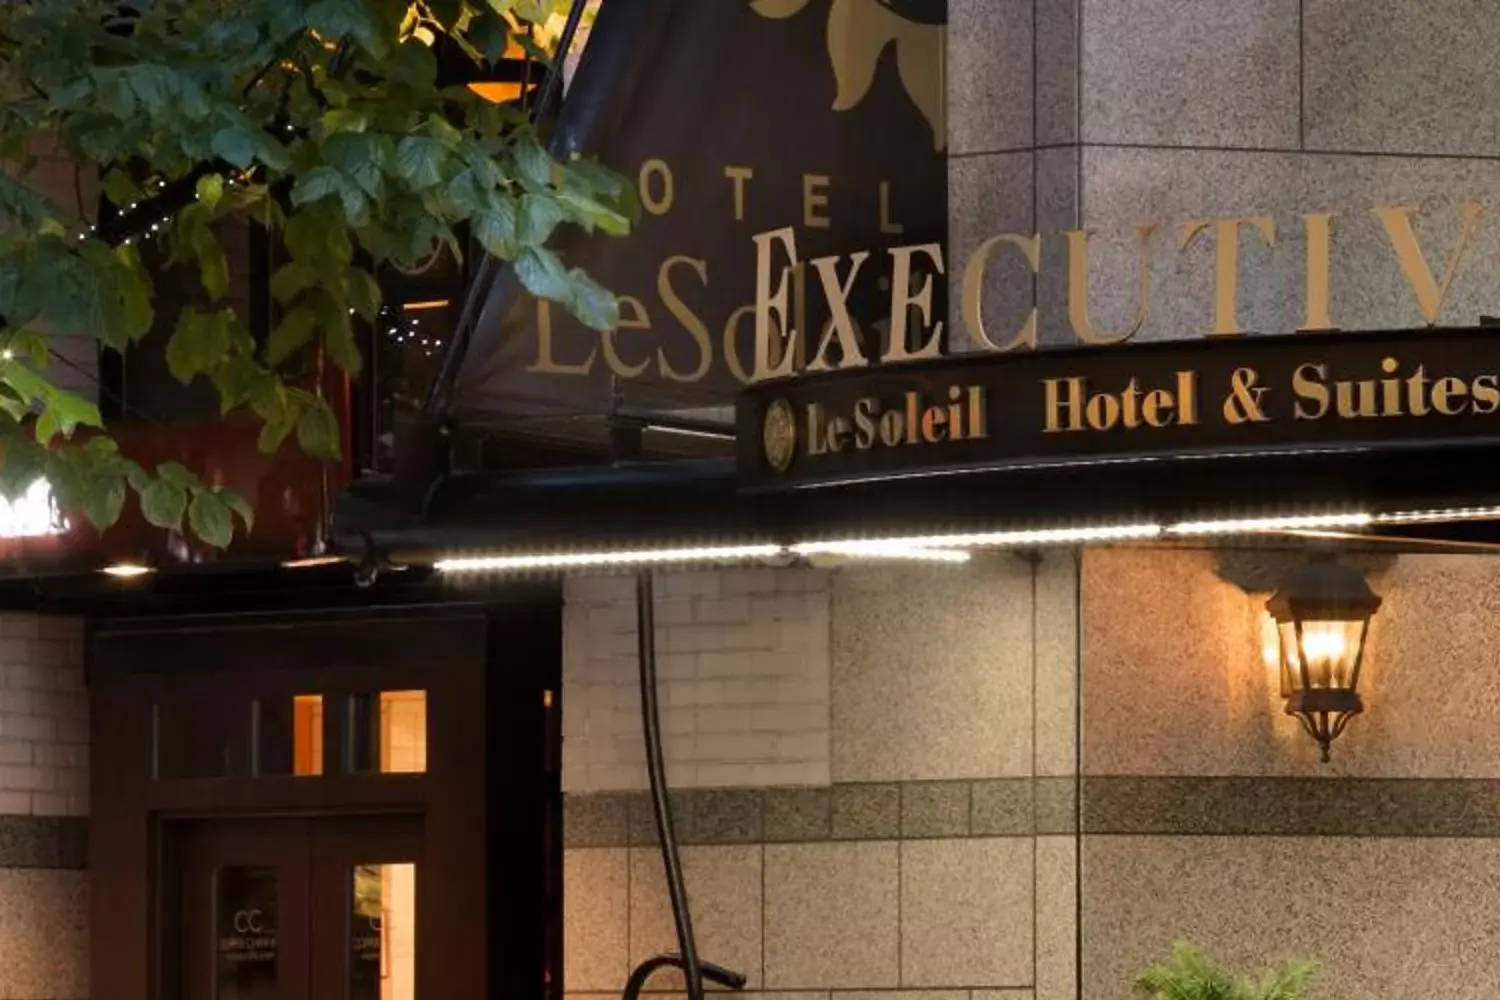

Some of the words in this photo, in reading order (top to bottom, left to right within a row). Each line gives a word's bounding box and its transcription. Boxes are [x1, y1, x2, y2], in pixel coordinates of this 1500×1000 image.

[549, 158, 905, 234] OTEL
[806, 384, 989, 456] LeSoleil
[1042, 369, 1201, 433] Hotel
[1222, 366, 1272, 425] &
